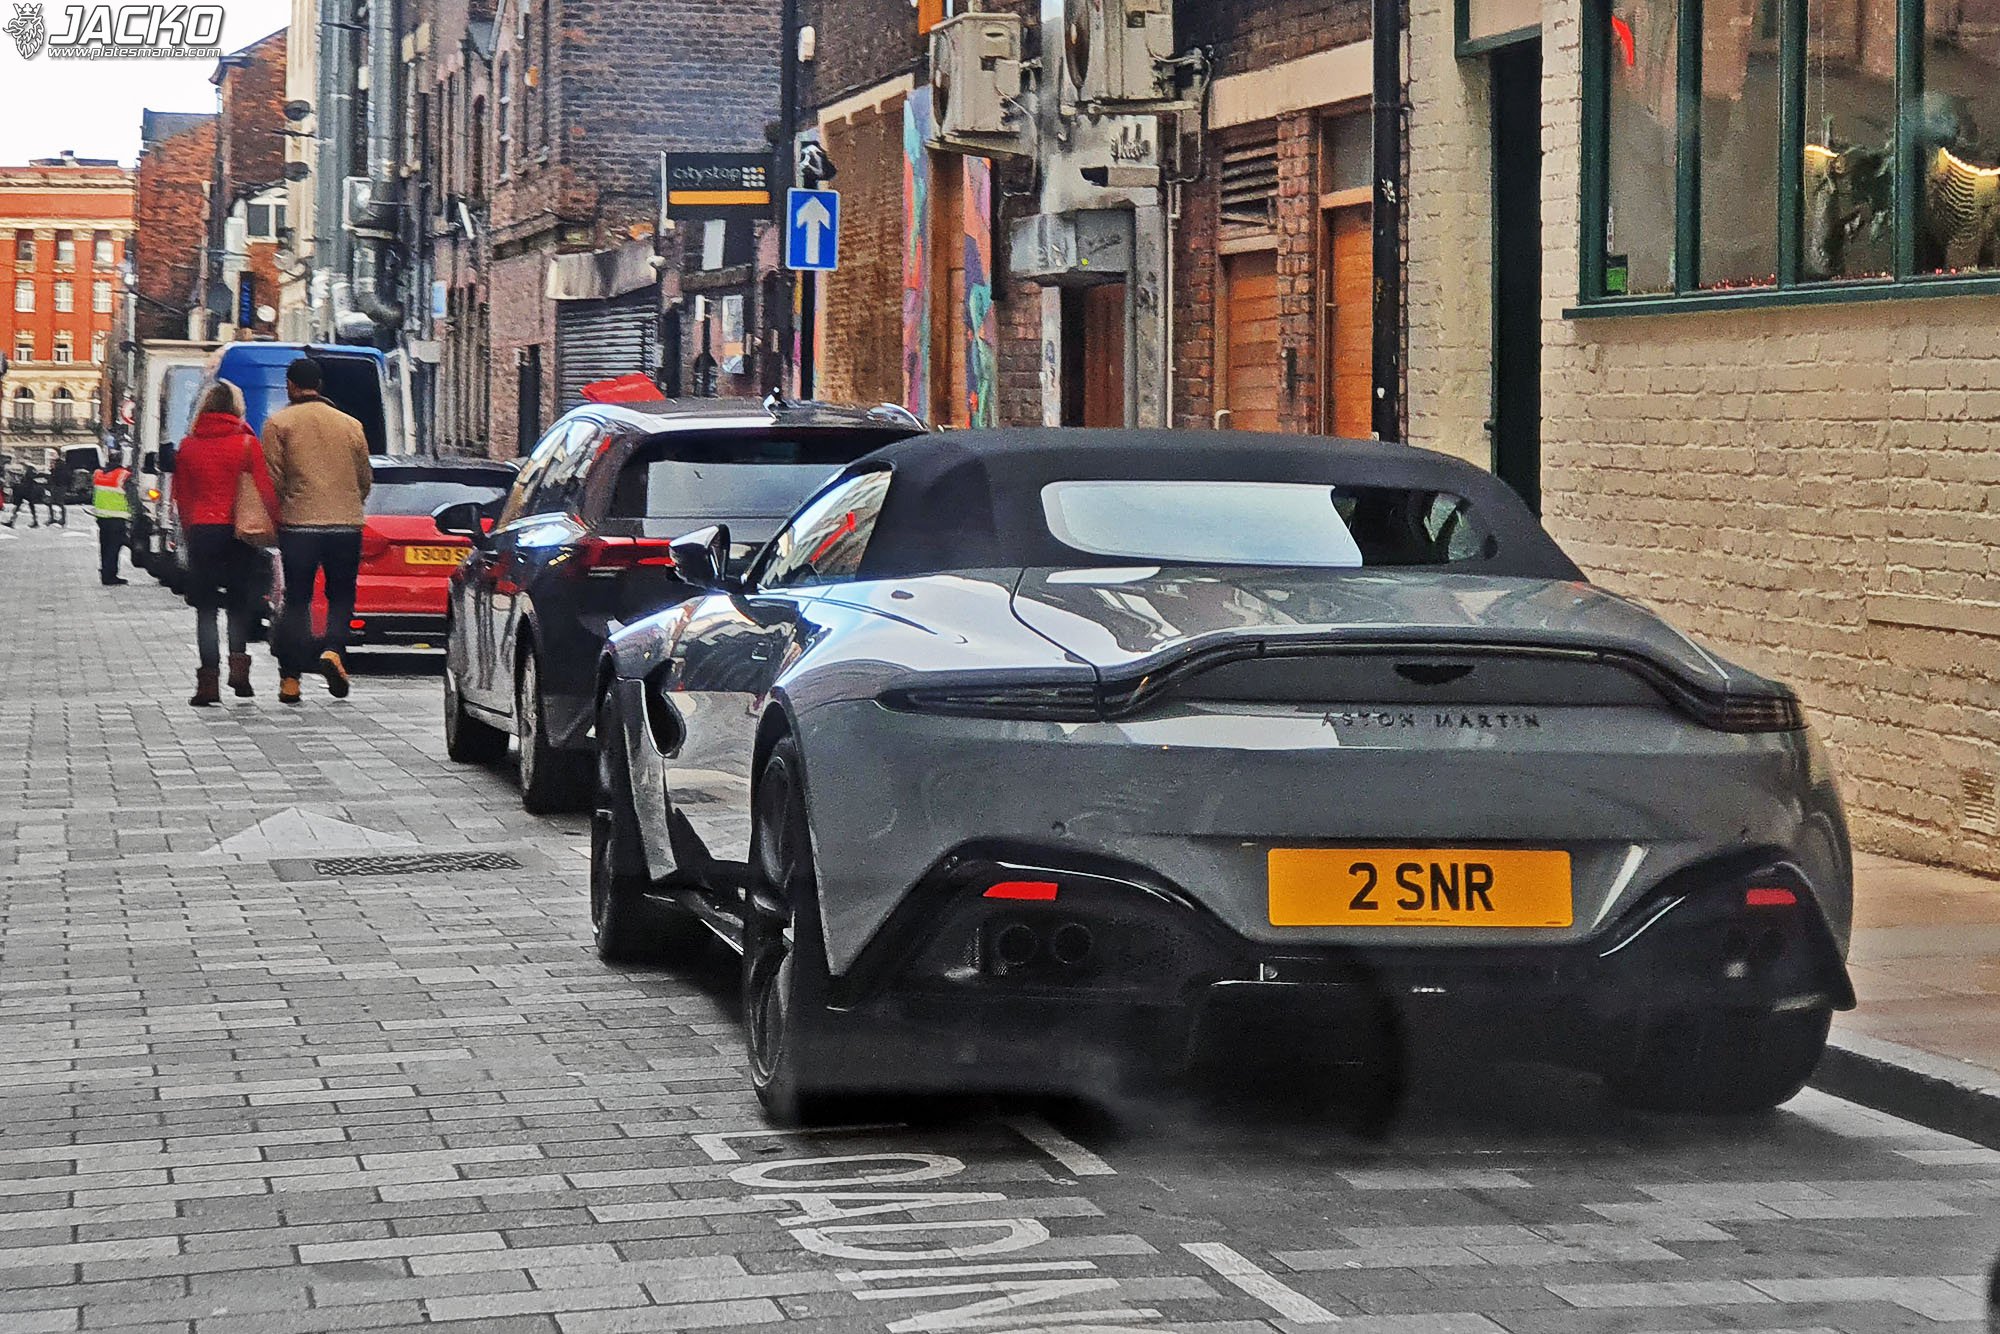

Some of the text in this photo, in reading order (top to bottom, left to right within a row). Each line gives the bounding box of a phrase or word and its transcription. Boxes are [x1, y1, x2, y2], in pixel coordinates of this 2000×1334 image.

[1436, 714, 1540, 728] MARTIN
[1348, 862, 1495, 912] 2 SNR
[692, 1122, 1178, 1334] LOADIN
